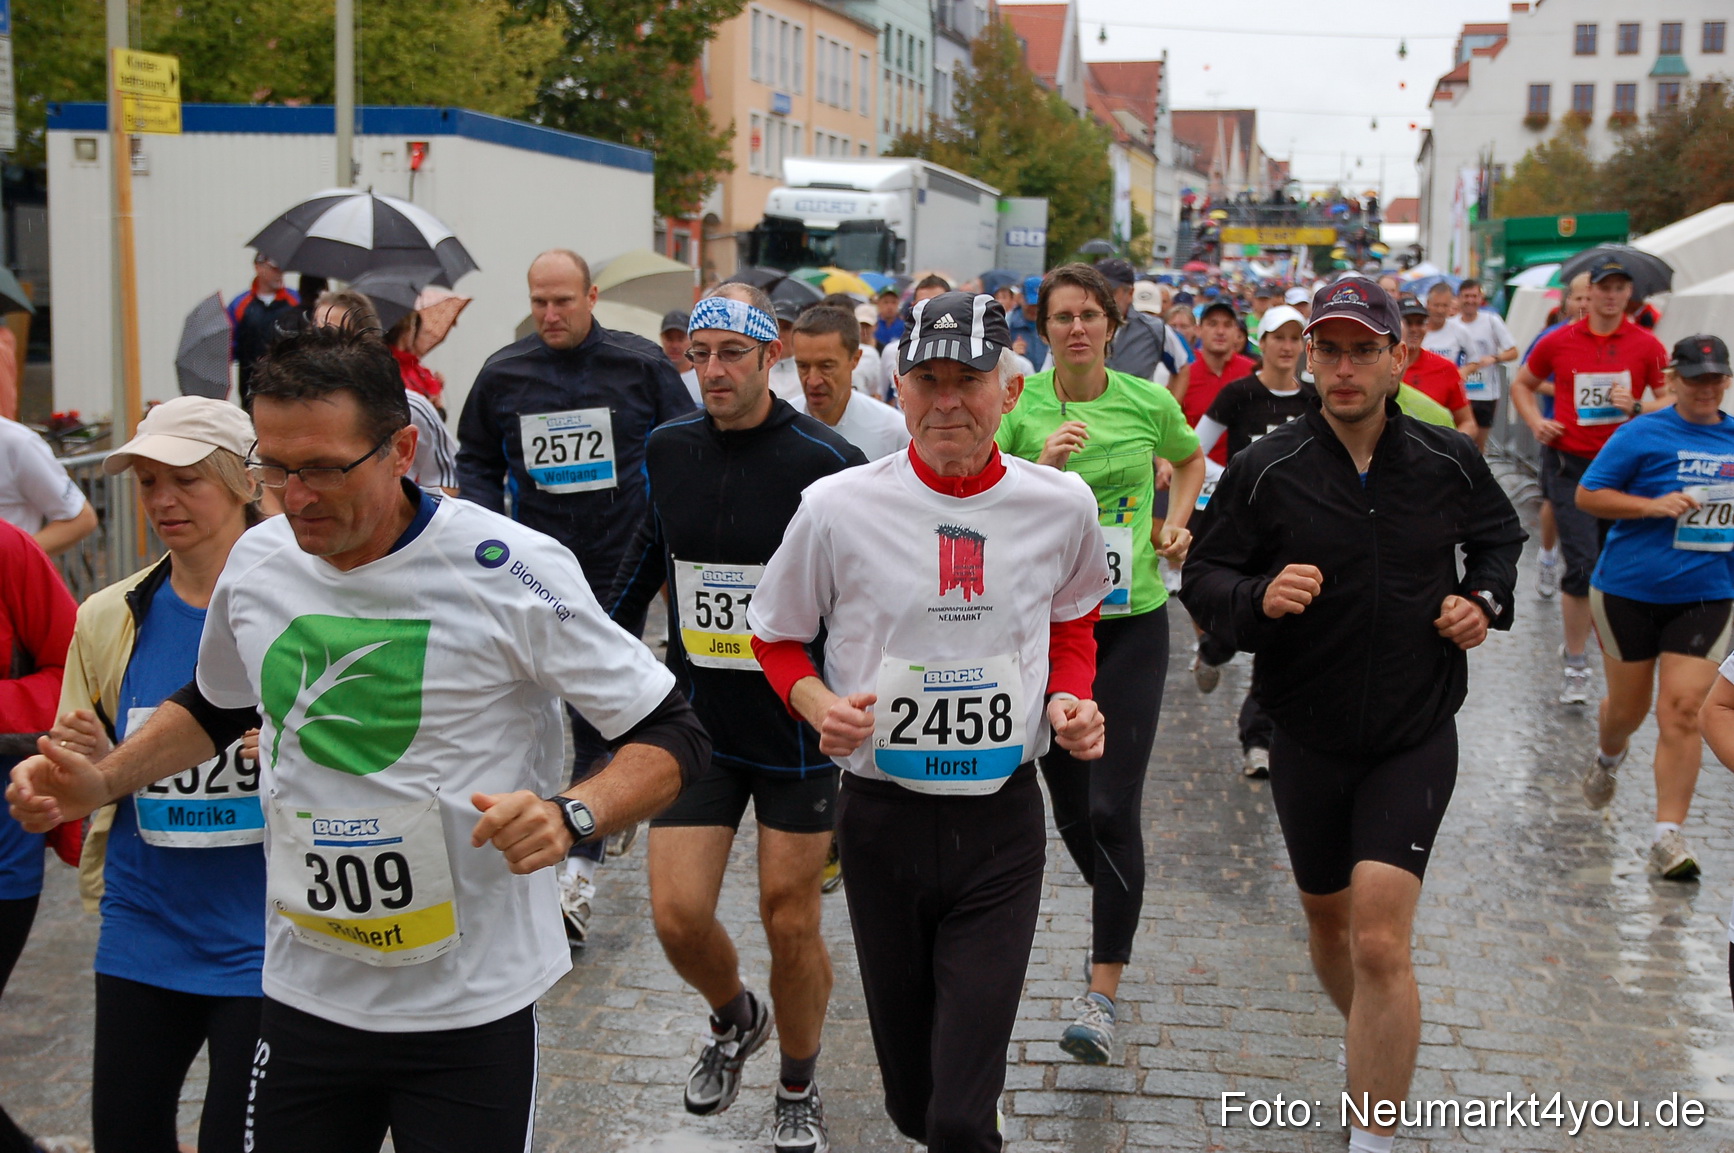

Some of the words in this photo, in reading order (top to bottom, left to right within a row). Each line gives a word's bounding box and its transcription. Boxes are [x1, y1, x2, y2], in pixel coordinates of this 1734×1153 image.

[1005, 226, 1046, 248] BO
[532, 431, 605, 465] 2572
[544, 469, 598, 483] Wolfgang
[1678, 459, 1720, 477] LAUF
[1687, 503, 1734, 526] 270
[702, 571, 744, 582] BOCK
[939, 613, 982, 622] NEUMARKT
[709, 639, 741, 655] Jens
[923, 667, 984, 684] BOCK
[889, 693, 1013, 745] 2458
[925, 757, 978, 776] Horst
[168, 806, 236, 826] Morika
[313, 818, 380, 836] BOCK
[305, 851, 413, 914] 309
